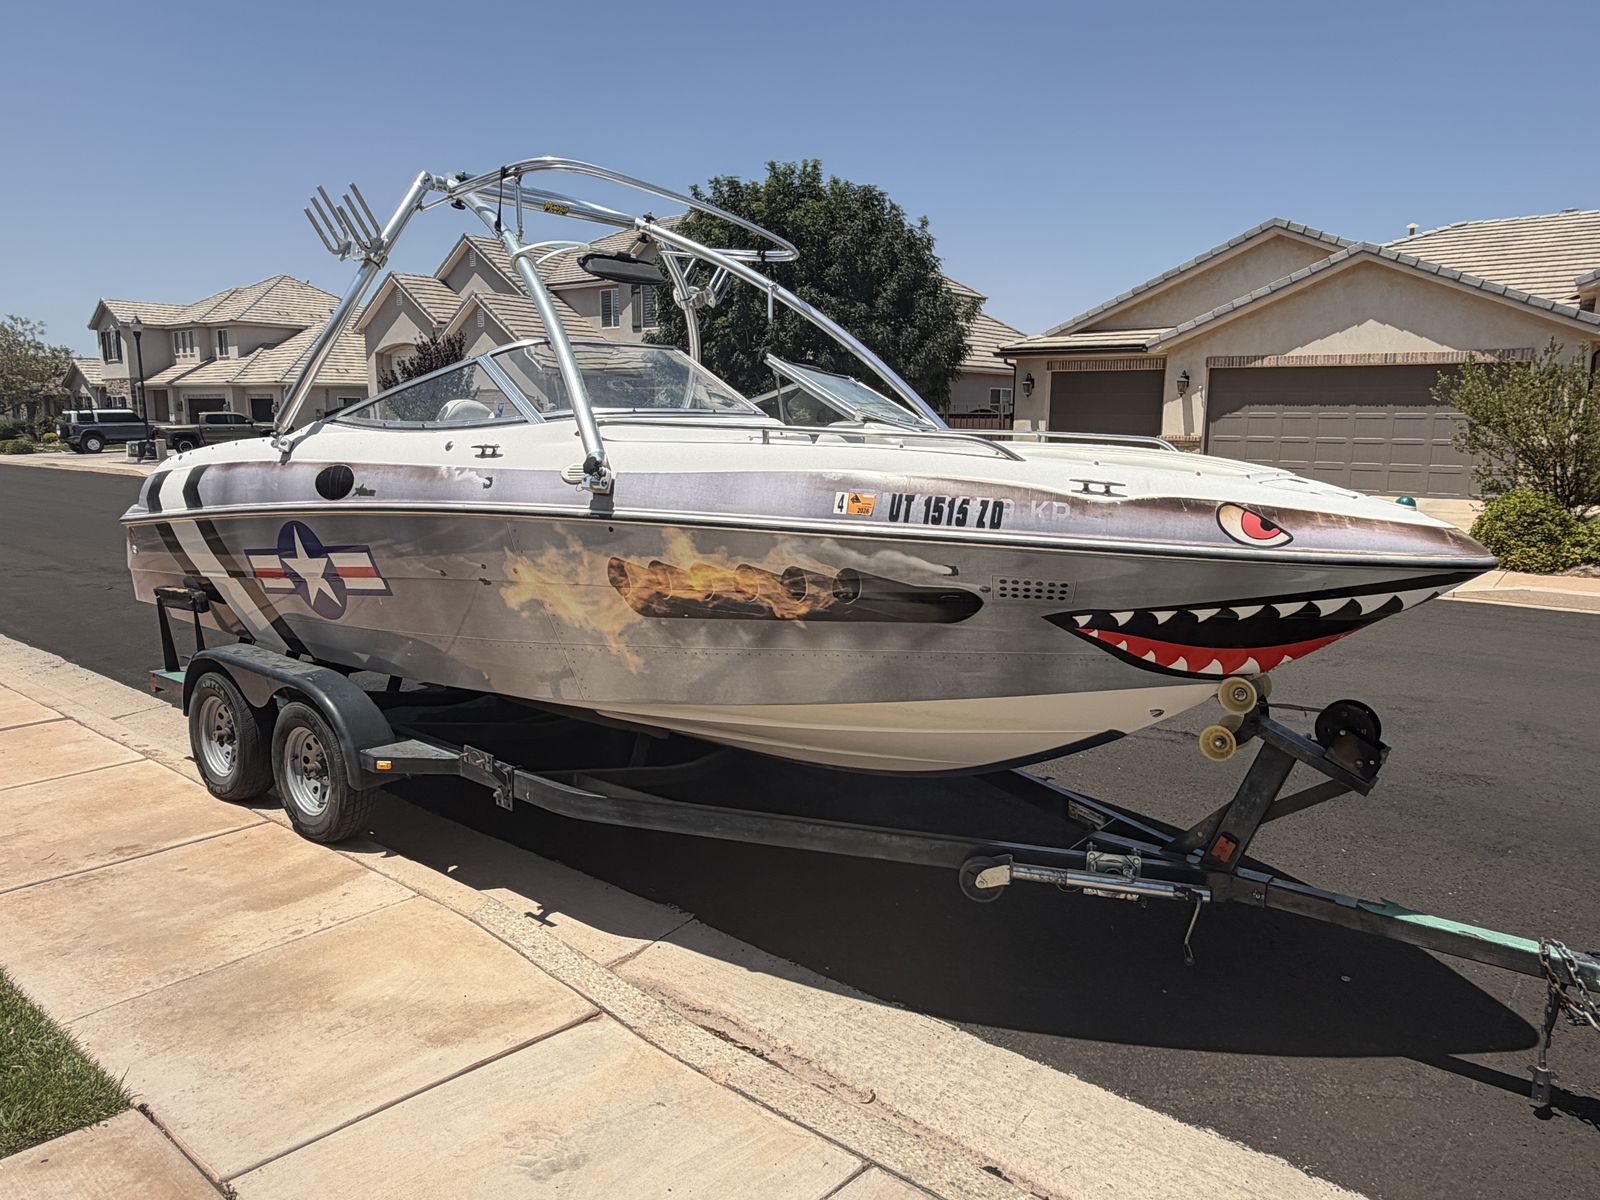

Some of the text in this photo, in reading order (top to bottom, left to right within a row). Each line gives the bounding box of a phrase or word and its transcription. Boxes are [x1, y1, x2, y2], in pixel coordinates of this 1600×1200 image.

[837, 493, 845, 513] 4
[888, 493, 916, 524] UT
[923, 496, 970, 527] 1515
